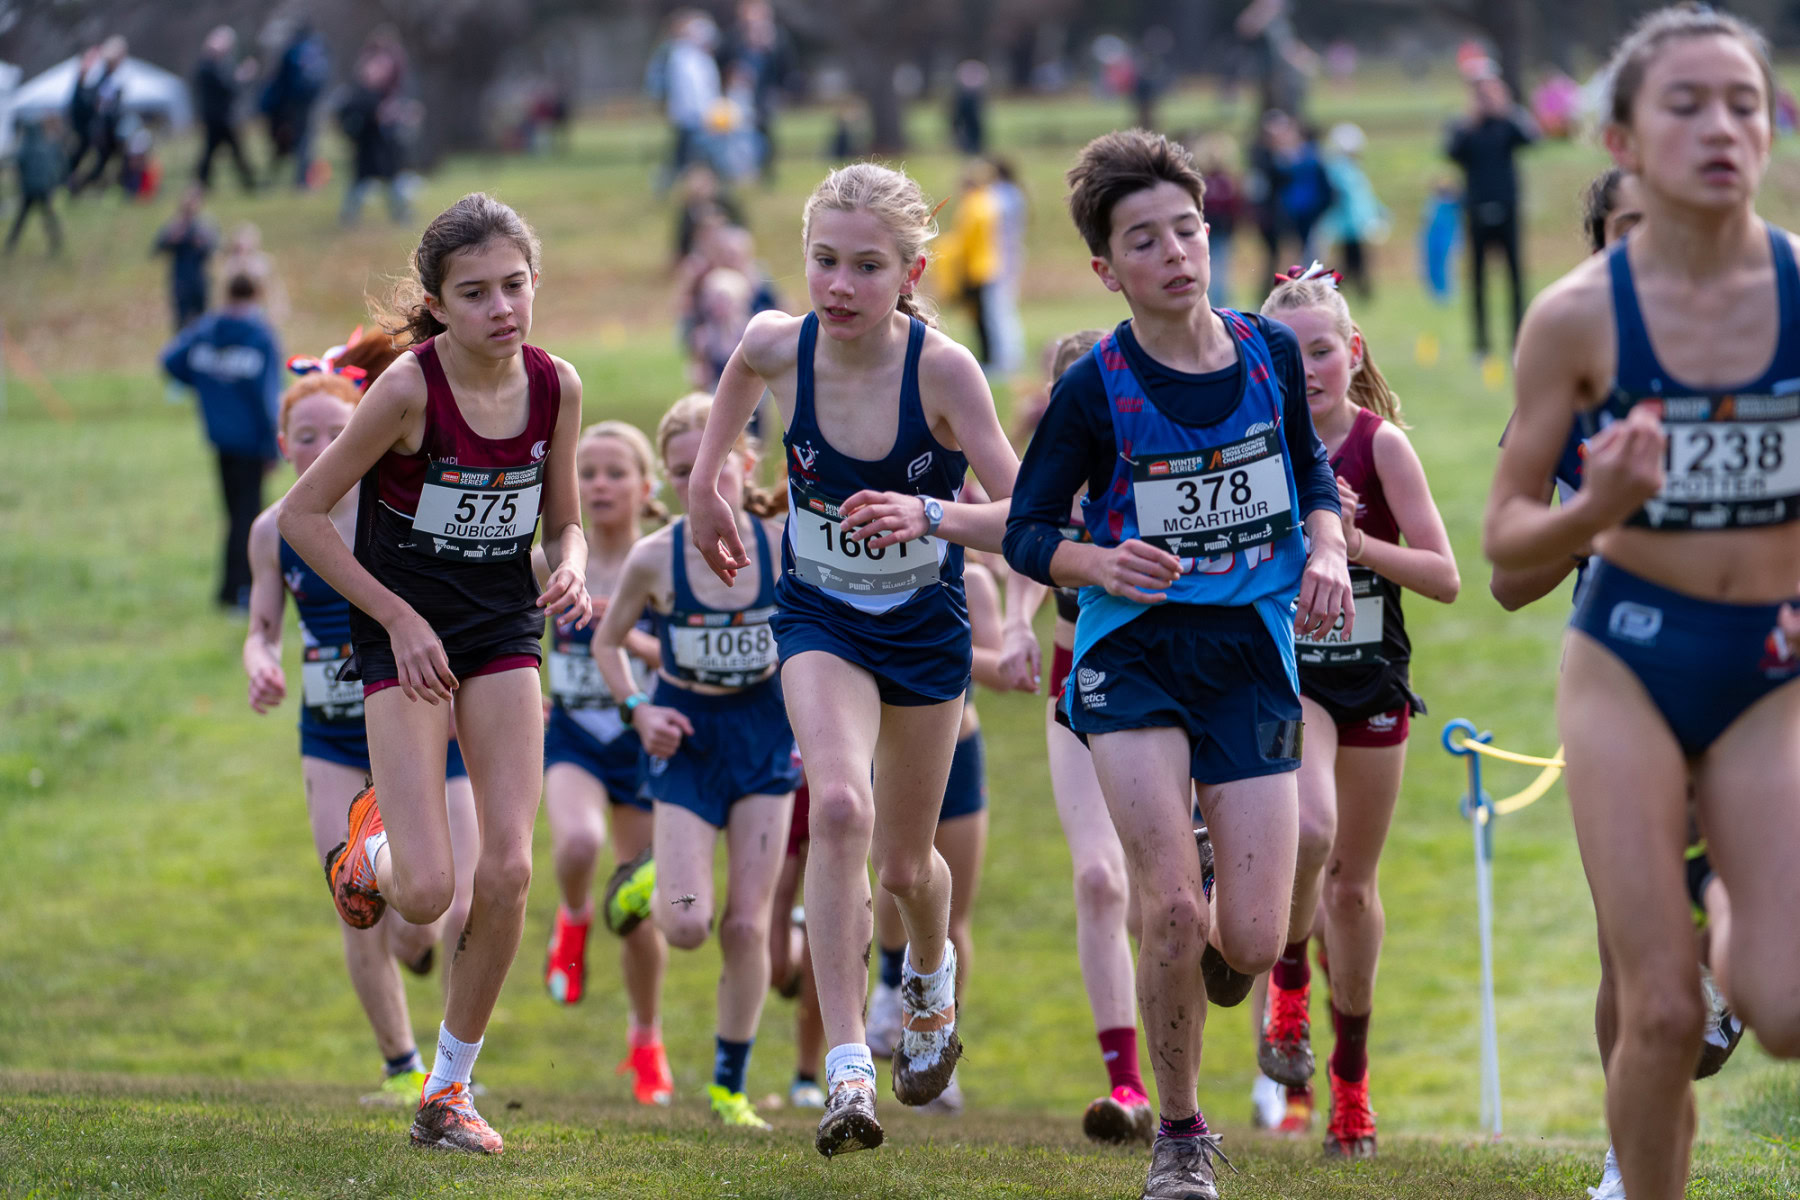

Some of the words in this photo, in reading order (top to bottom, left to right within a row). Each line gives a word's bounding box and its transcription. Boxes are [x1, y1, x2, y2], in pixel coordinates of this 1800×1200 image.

[1222, 449, 1241, 458] CROSS
[1241, 441, 1266, 453] COUNTRY
[1666, 430, 1782, 474] 1238
[1169, 456, 1203, 466] WINTER
[1170, 464, 1197, 473] SERIES
[460, 478, 483, 486] SERIES
[461, 472, 490, 481] WINTER
[1175, 470, 1252, 515] 378
[454, 493, 519, 524] 575
[1163, 501, 1269, 532] MCARTHUR
[444, 522, 516, 538] DUBICZKI
[1204, 540, 1228, 551] PUMA
[849, 582, 871, 591] PUMA
[698, 628, 769, 656] 1068
